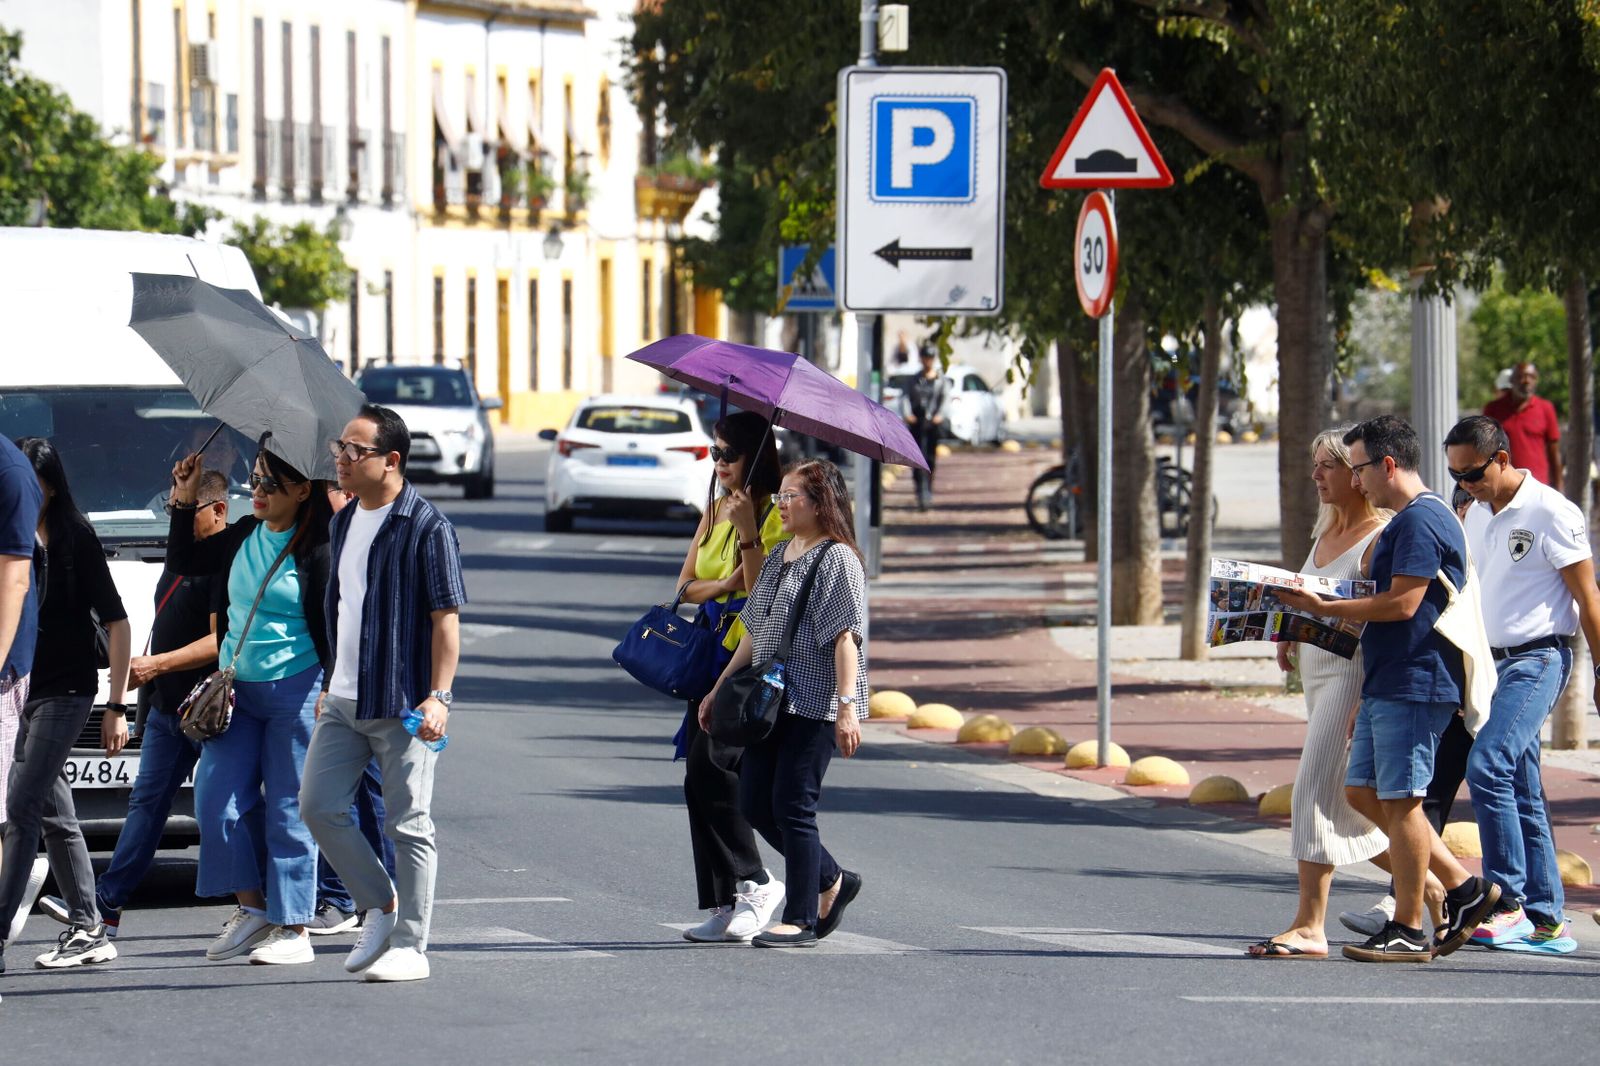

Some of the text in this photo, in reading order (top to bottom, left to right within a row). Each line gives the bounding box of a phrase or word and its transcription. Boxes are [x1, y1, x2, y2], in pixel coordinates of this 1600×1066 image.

[891, 108, 955, 188] P
[1083, 236, 1104, 275] 30
[65, 760, 130, 784] 9484
